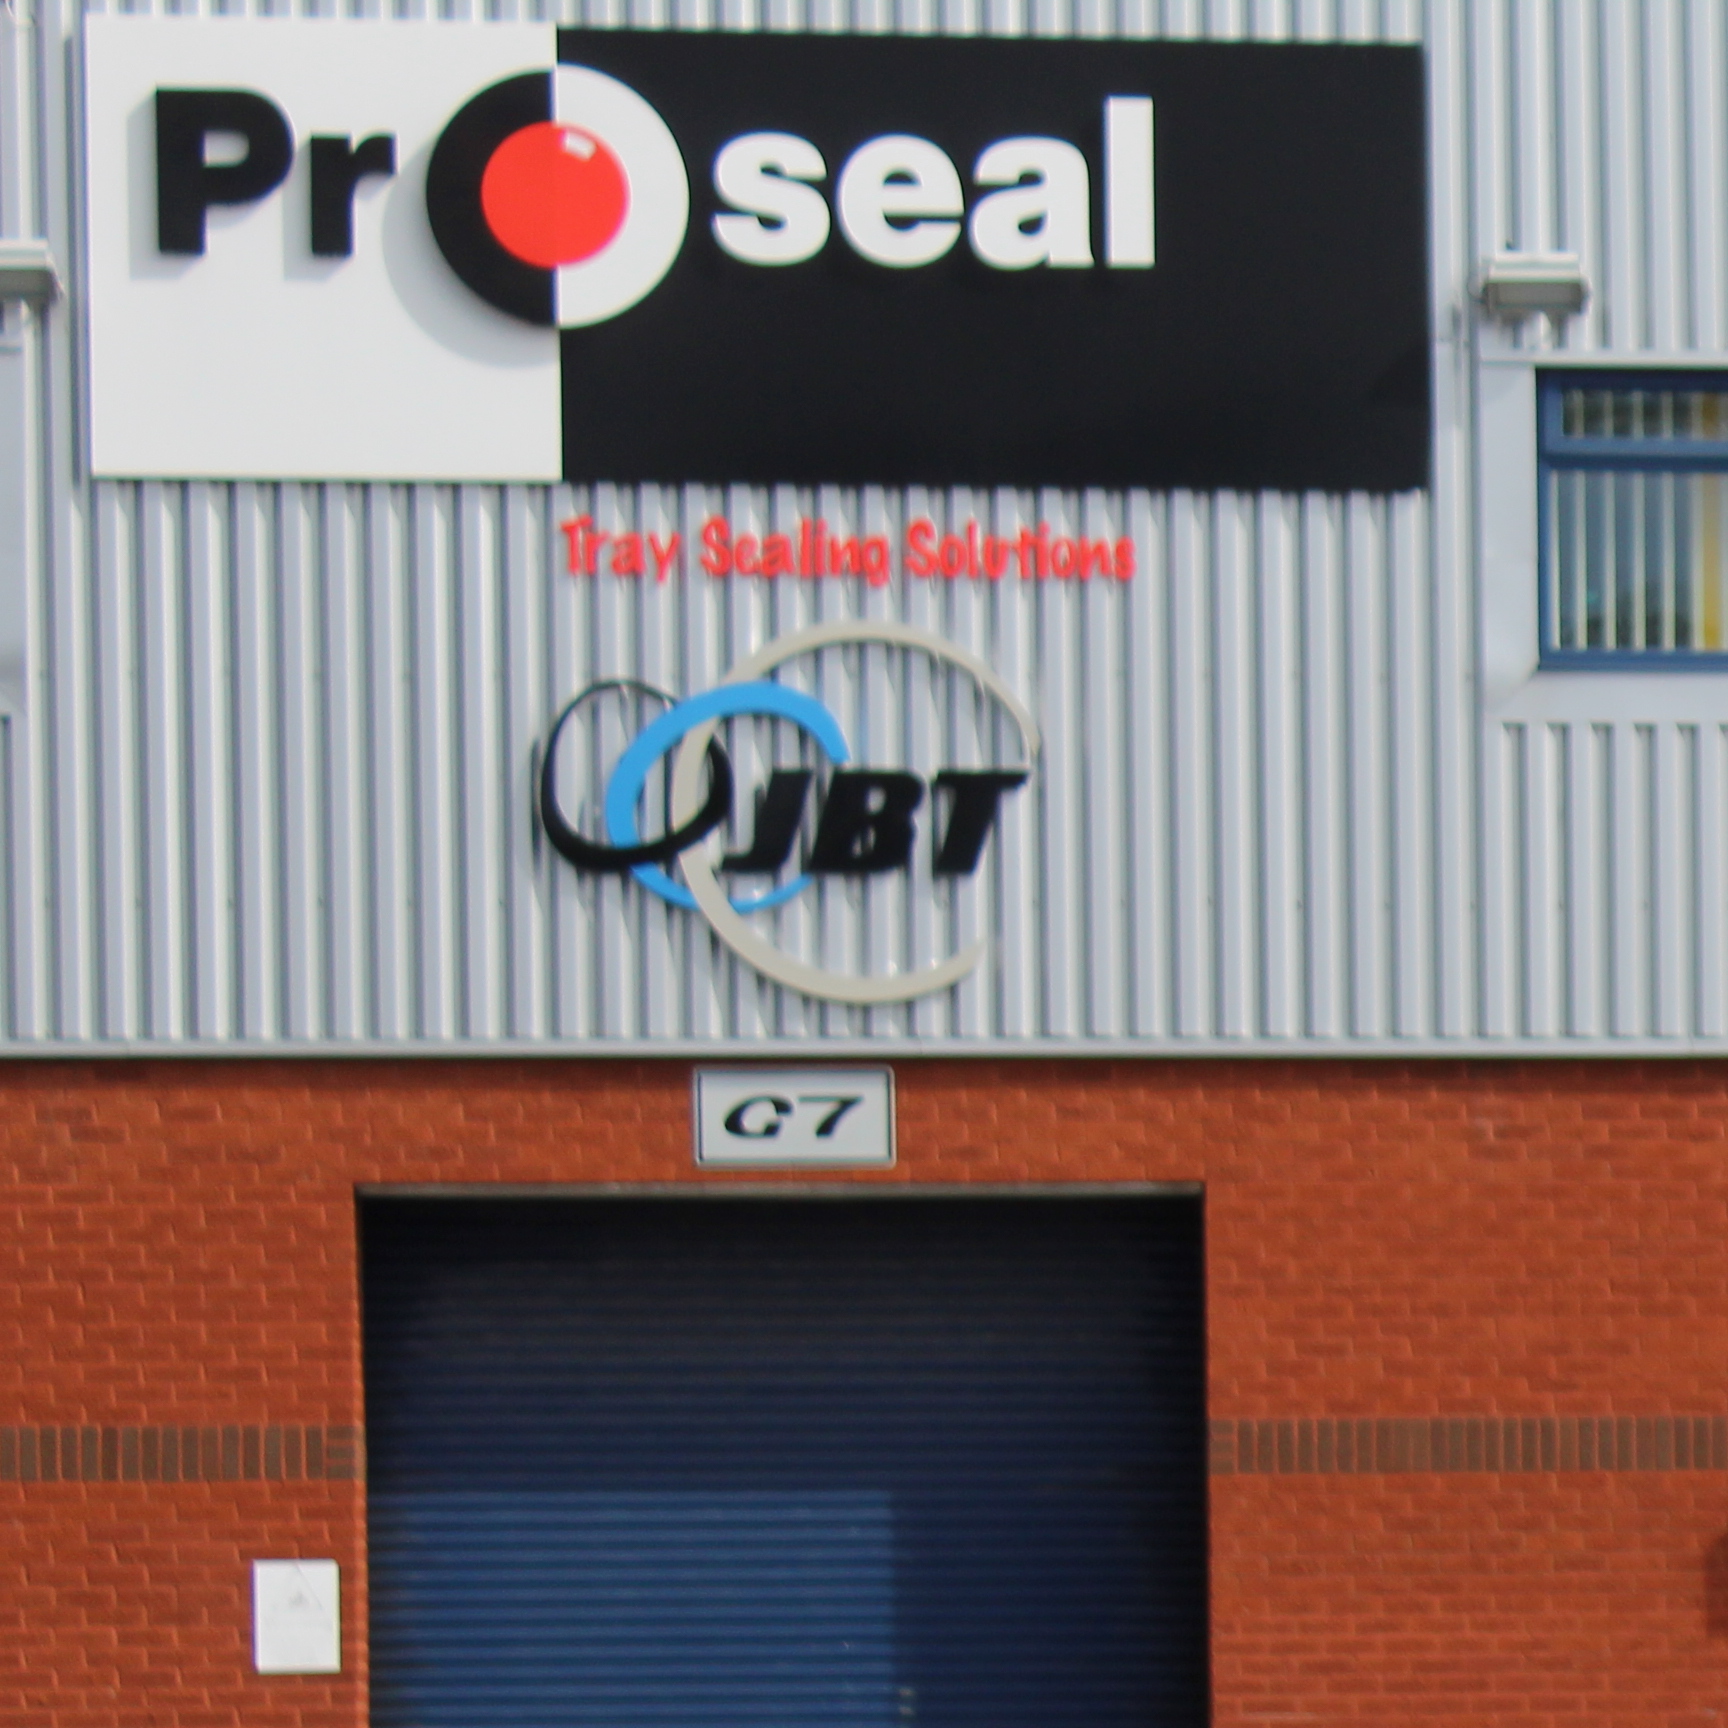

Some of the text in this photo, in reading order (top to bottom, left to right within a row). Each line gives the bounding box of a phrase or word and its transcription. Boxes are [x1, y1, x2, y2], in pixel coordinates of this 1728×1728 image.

[561, 515, 1137, 588] Tray Sealing Solutions
[718, 766, 1031, 880] JBT
[724, 1093, 865, 1139] G7
